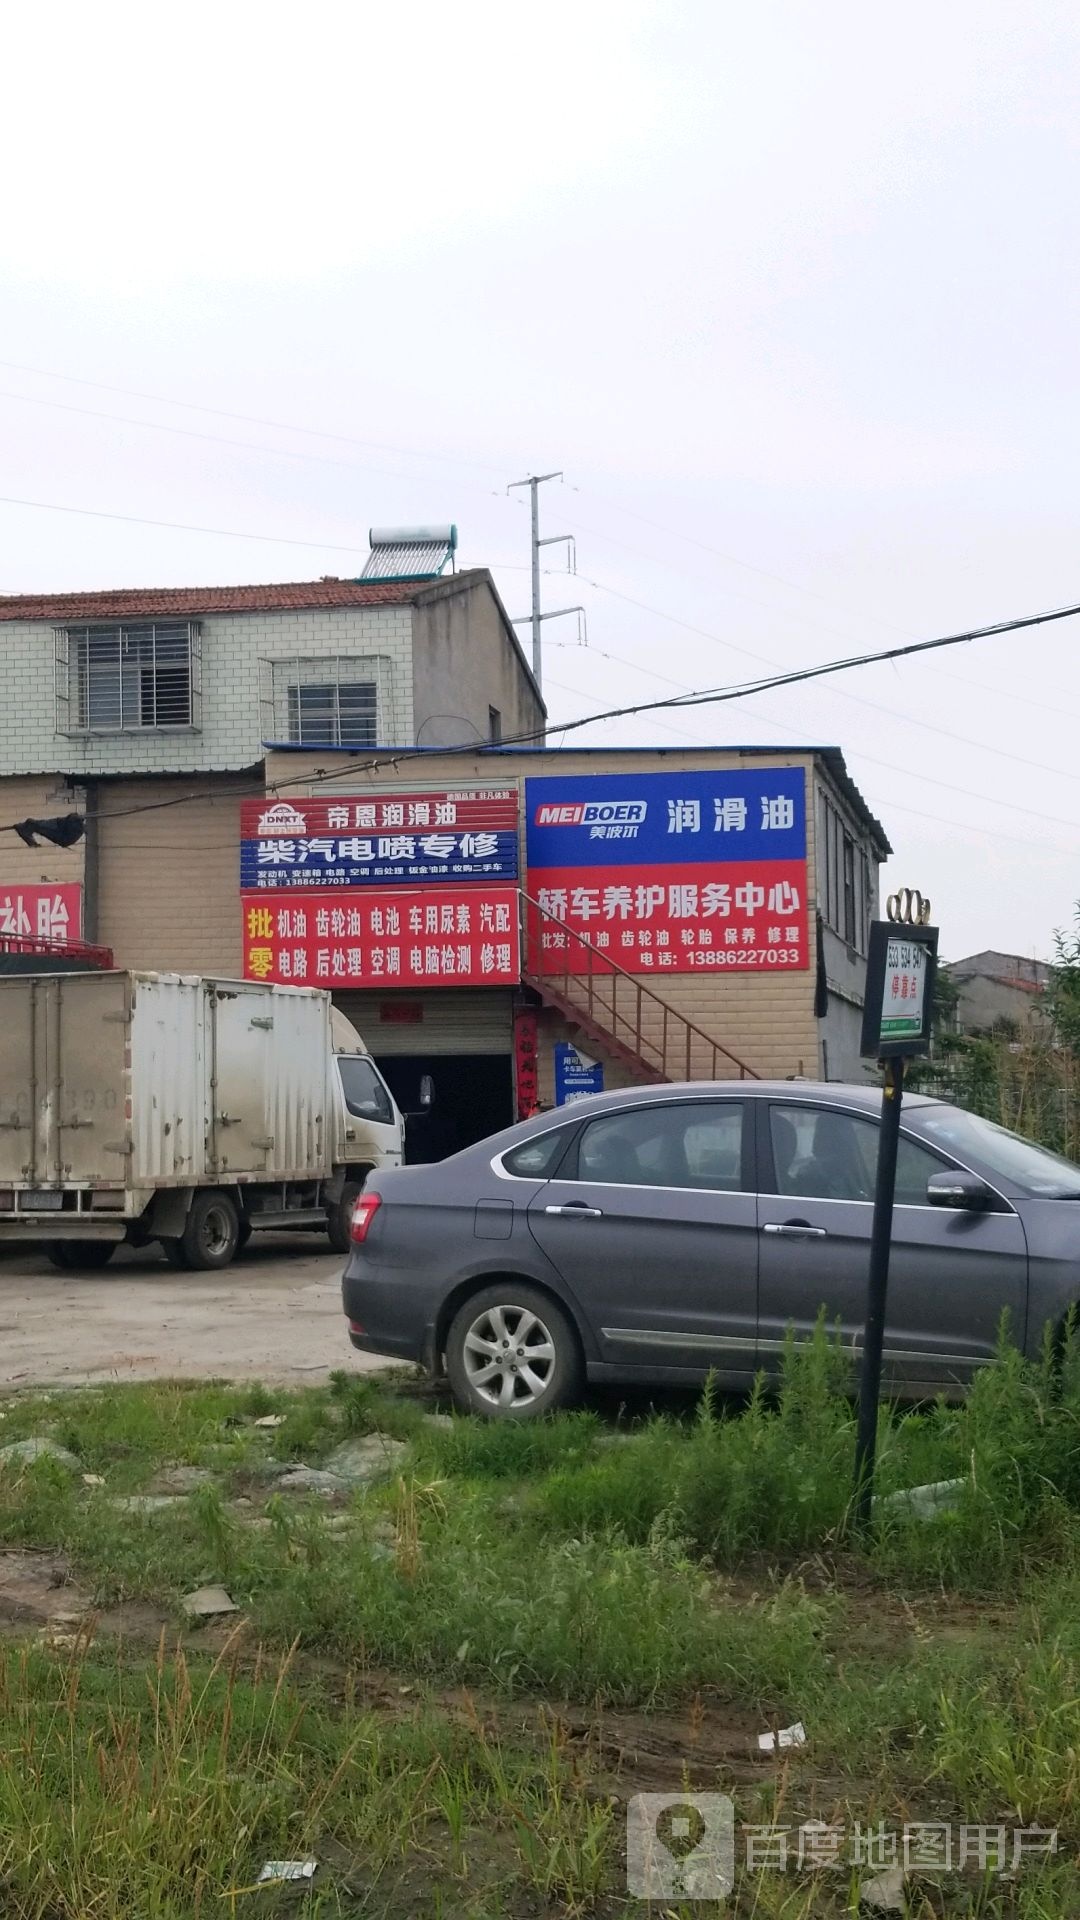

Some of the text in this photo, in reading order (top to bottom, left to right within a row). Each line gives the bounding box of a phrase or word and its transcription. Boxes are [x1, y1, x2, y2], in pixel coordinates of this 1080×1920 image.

[328, 802, 457, 828] 帝恩润滑油
[539, 805, 643, 823] MEIBOER
[667, 795, 794, 833] 润滑油
[257, 833, 499, 863] 柴汽电喷专修
[589, 826, 639, 840] 美波尔
[537, 881, 800, 921] 轿车养护服务中心
[247, 903, 511, 938] 批 机油 齿轮油 电池 车用尿素 汽配
[621, 930, 669, 947] 齿轮油
[681, 929, 712, 945] 轮胎
[724, 927, 756, 944] 保养
[768, 926, 799, 943] 修理
[248, 943, 512, 978] 零 电路 后处理 空调 电脑检测 修理
